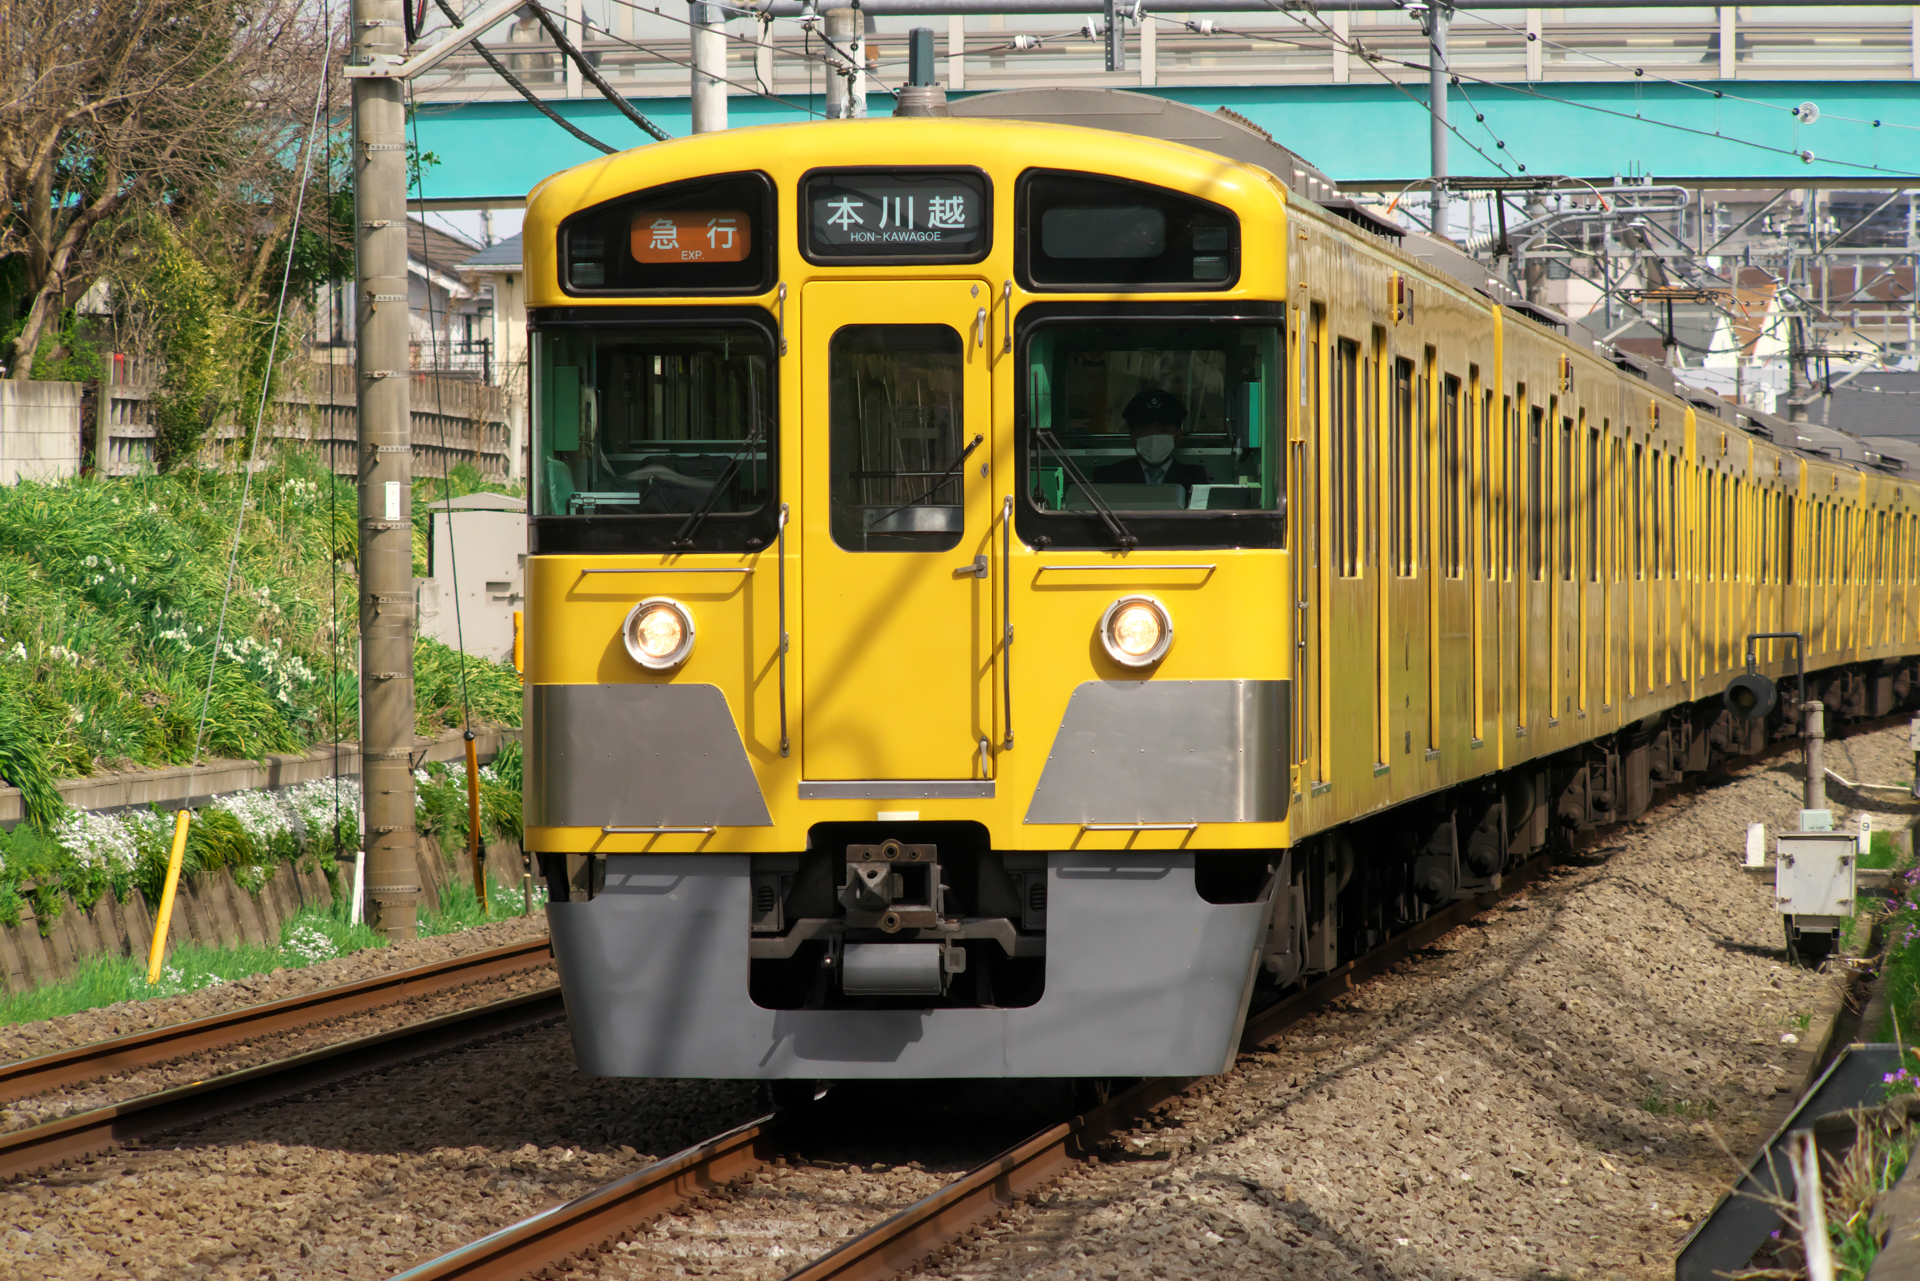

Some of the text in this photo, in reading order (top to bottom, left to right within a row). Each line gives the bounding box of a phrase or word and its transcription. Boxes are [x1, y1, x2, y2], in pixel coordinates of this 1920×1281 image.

[827, 195, 966, 231] 本川越
[649, 218, 738, 249] 急行
[850, 231, 942, 242] HON-KAWAGOE
[681, 250, 705, 261] EXP.
[1861, 822, 1870, 832] 9
